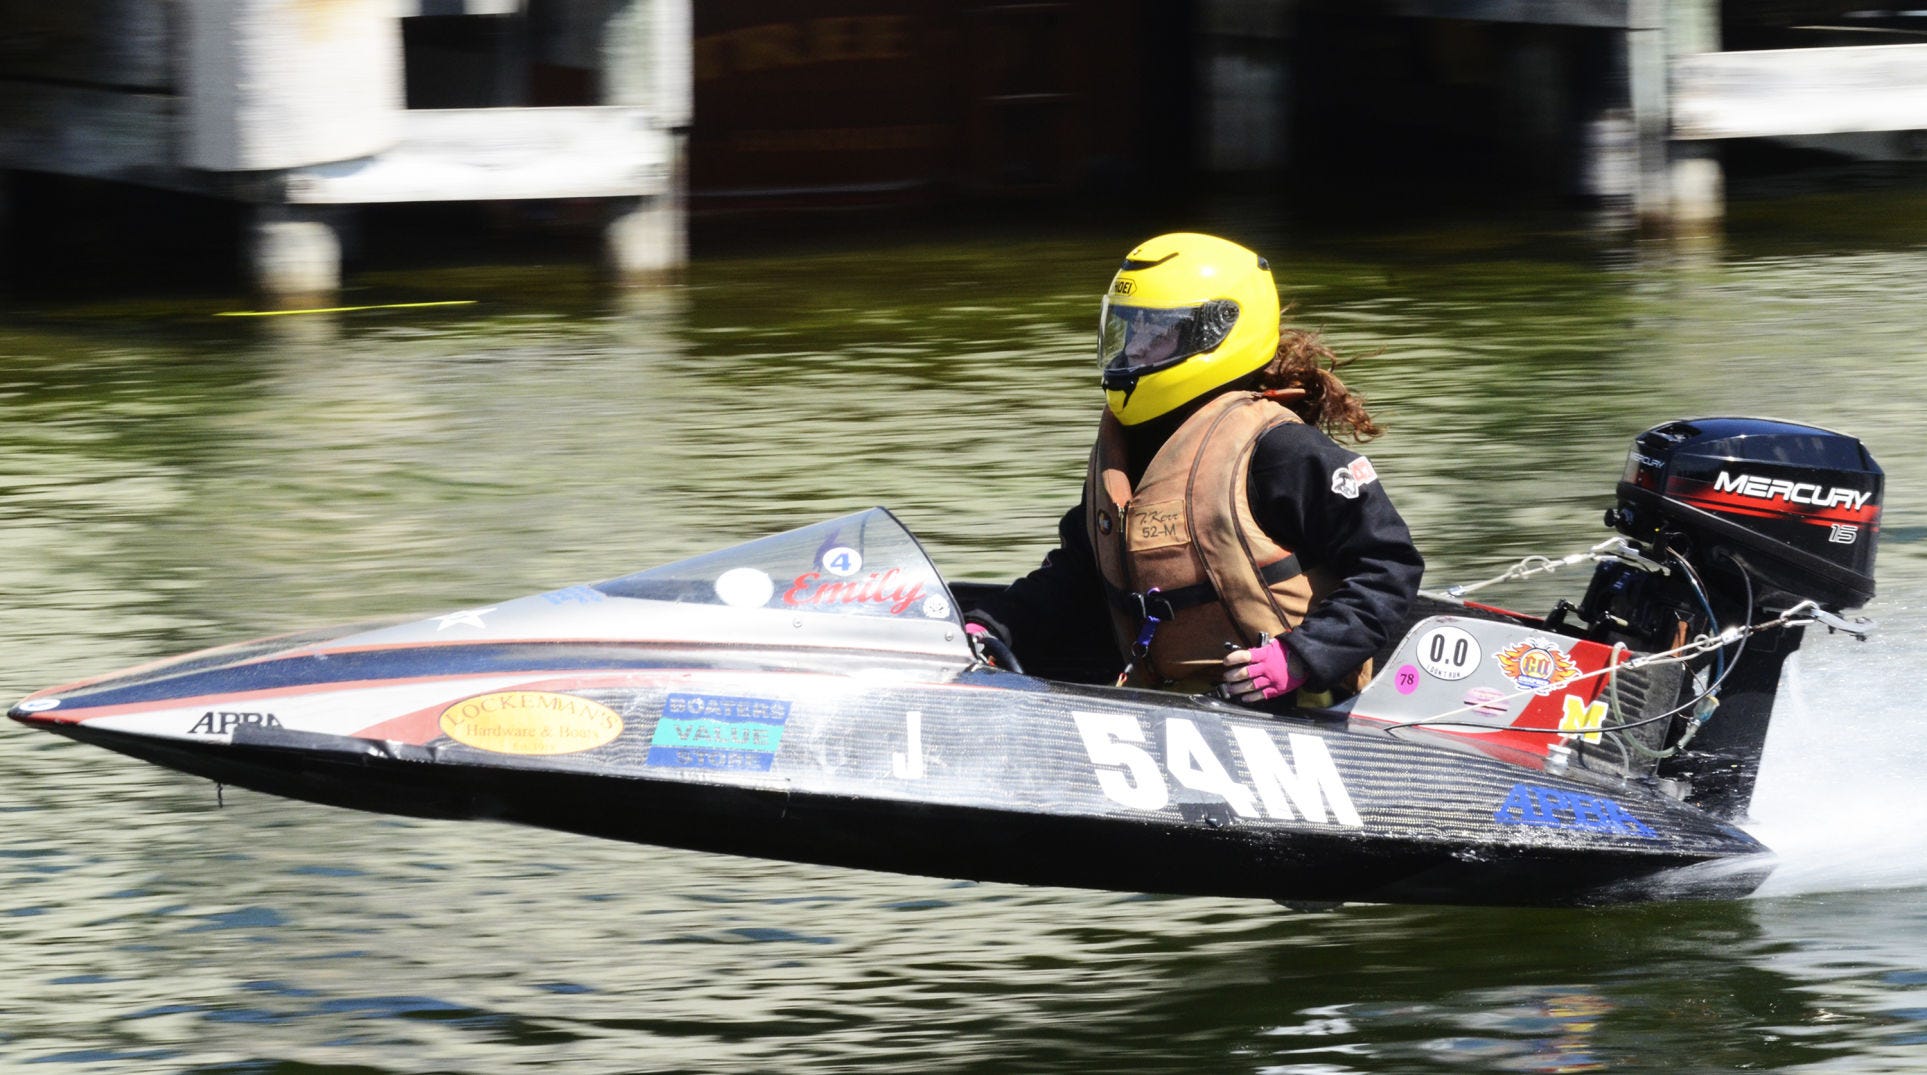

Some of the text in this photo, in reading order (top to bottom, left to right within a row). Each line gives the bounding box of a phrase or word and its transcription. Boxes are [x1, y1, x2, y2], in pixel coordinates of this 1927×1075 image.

[1630, 452, 1666, 468] MERCURY
[1713, 471, 1872, 511] MERCURY
[1142, 523, 1177, 538] 52-M
[1829, 523, 1858, 544] 15
[830, 552, 852, 572] 4
[783, 567, 926, 615] Emily
[1429, 633, 1469, 667] 0.0
[1400, 673, 1415, 686] 78
[444, 693, 616, 730] LOCKEMAN'S
[669, 697, 785, 720] BOATERS
[1559, 695, 1608, 743] M
[466, 723, 600, 739] Hardware & Boats
[674, 724, 770, 746] VALUE
[892, 711, 924, 779] J
[676, 749, 761, 770] STORE
[1072, 710, 1364, 827] 54M
[1494, 783, 1658, 838] APBA
